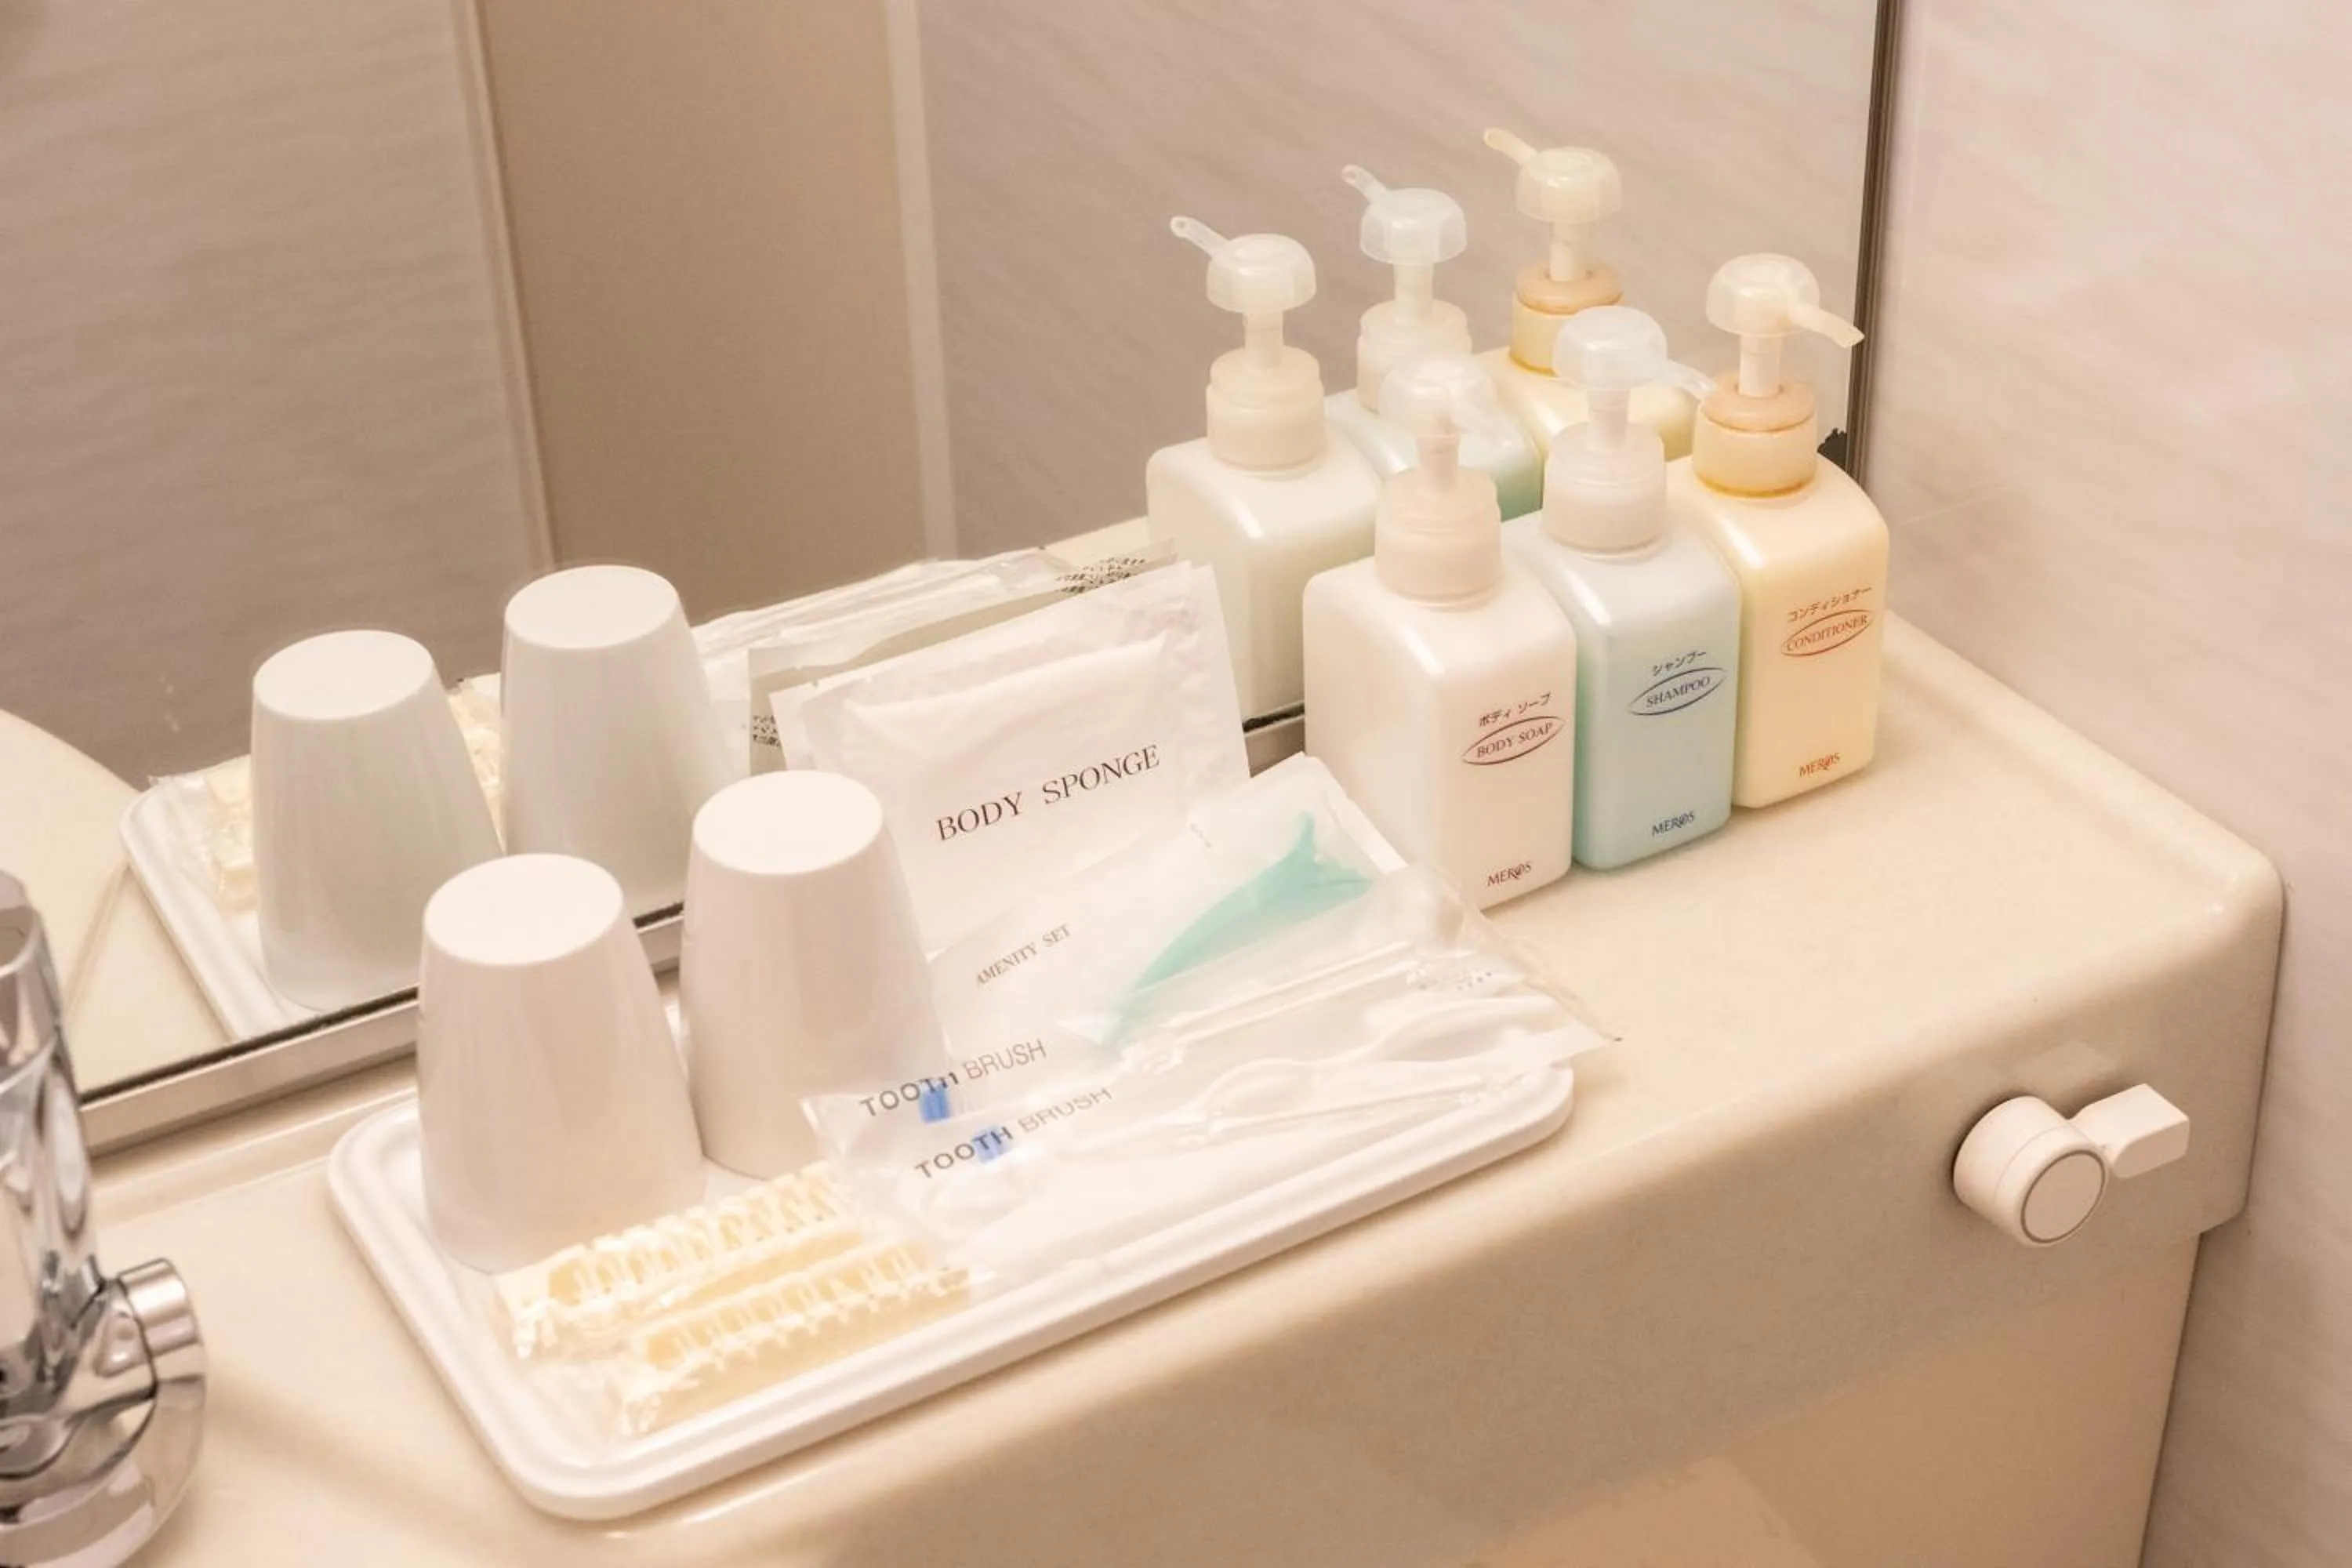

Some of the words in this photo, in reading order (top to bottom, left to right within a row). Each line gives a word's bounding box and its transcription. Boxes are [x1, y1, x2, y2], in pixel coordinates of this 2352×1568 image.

[1786, 614, 1868, 652] CONDITIONER
[1646, 676, 1711, 707] SHAMPOO
[1475, 736, 1514, 758] BODY
[1518, 721, 1553, 744] SOAP
[936, 790, 1023, 840] BODY
[1041, 744, 1160, 804] SPONGE
[977, 942, 1037, 987] AMENITY
[1042, 923, 1071, 948] SET
[962, 1038, 1047, 1080] BRUSH
[914, 1126, 1014, 1178] TOOTH
[1018, 1087, 1113, 1134] BRUSH
